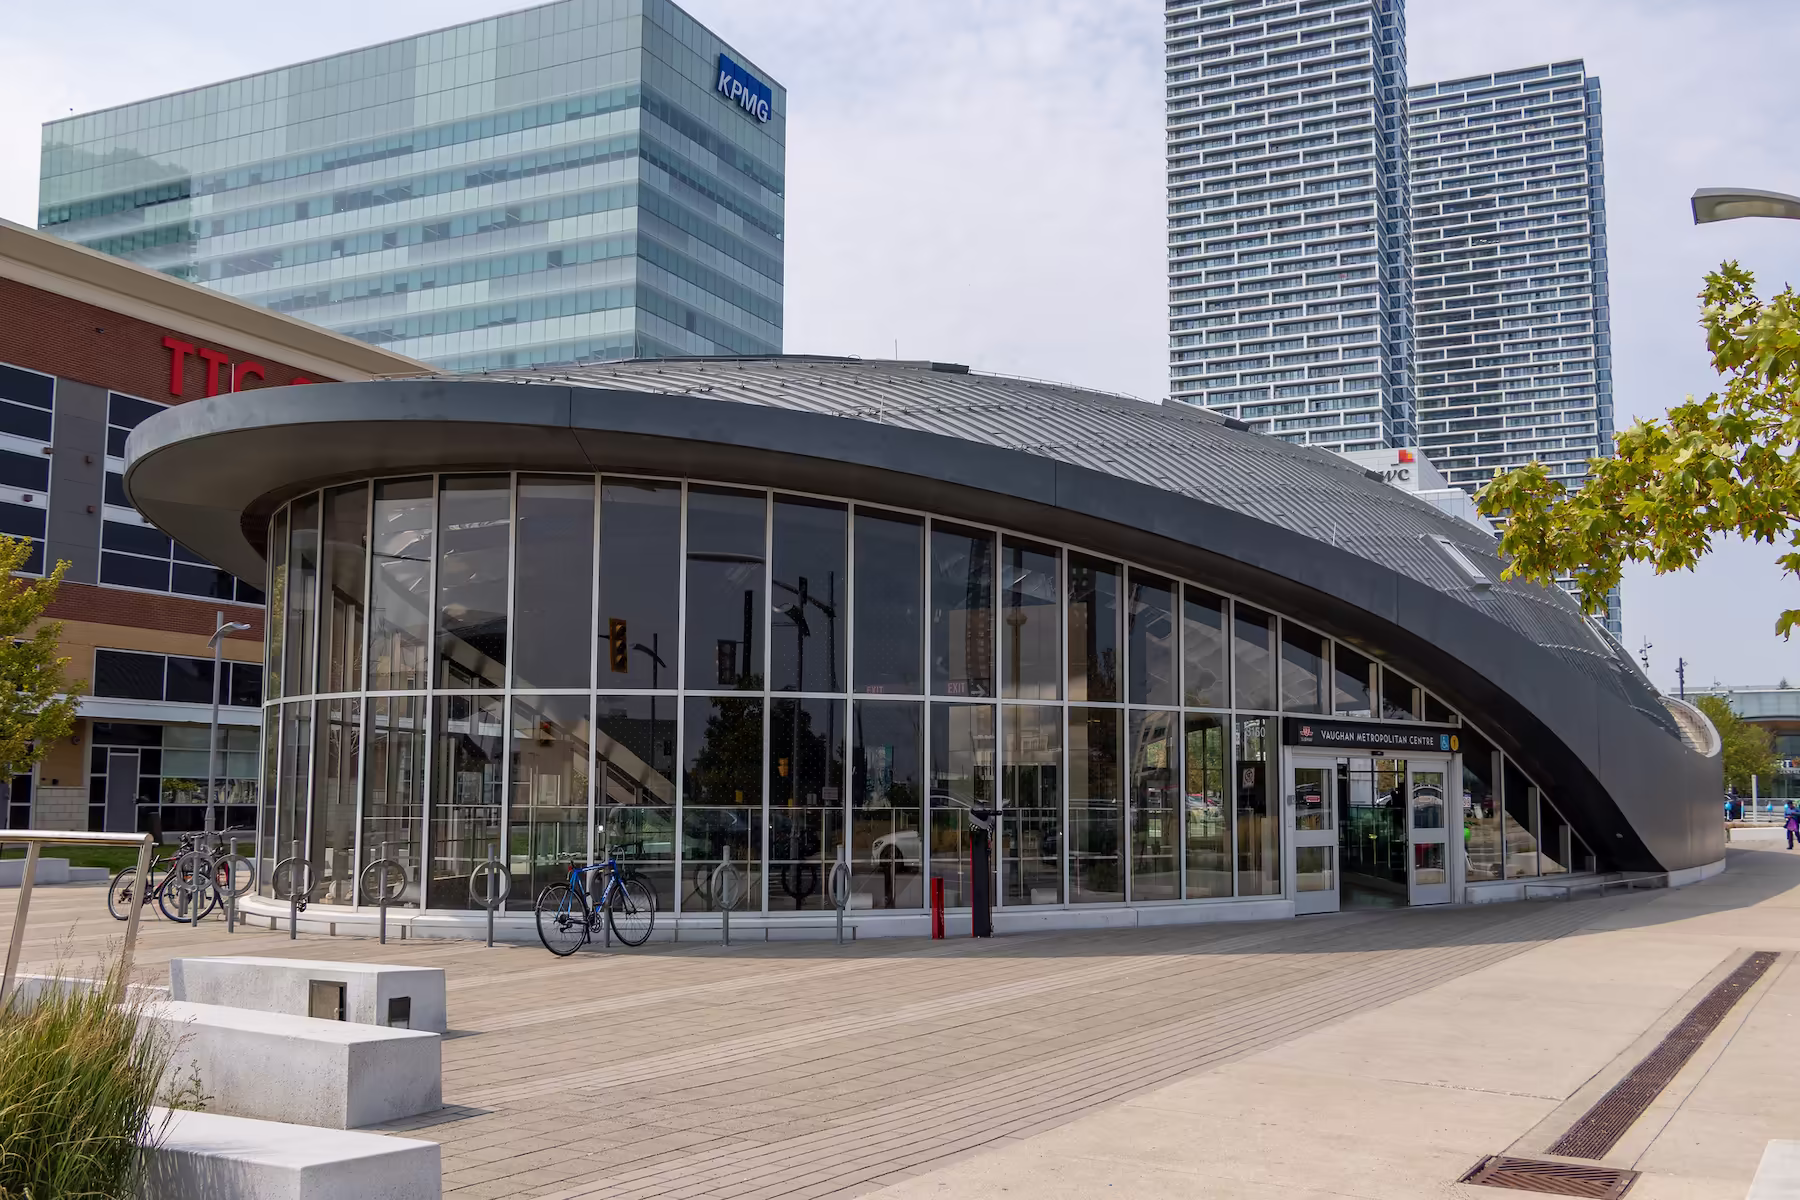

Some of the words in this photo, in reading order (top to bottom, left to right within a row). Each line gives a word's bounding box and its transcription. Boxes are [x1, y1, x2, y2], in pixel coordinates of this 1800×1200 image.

[718, 70, 769, 123] KPMG
[163, 336, 265, 398] TTC
[948, 682, 965, 694] EXIT
[1321, 730, 1354, 742] VAUGHAN
[1356, 733, 1407, 744] METROPOLITAN
[1409, 736, 1434, 746] CENTRE
